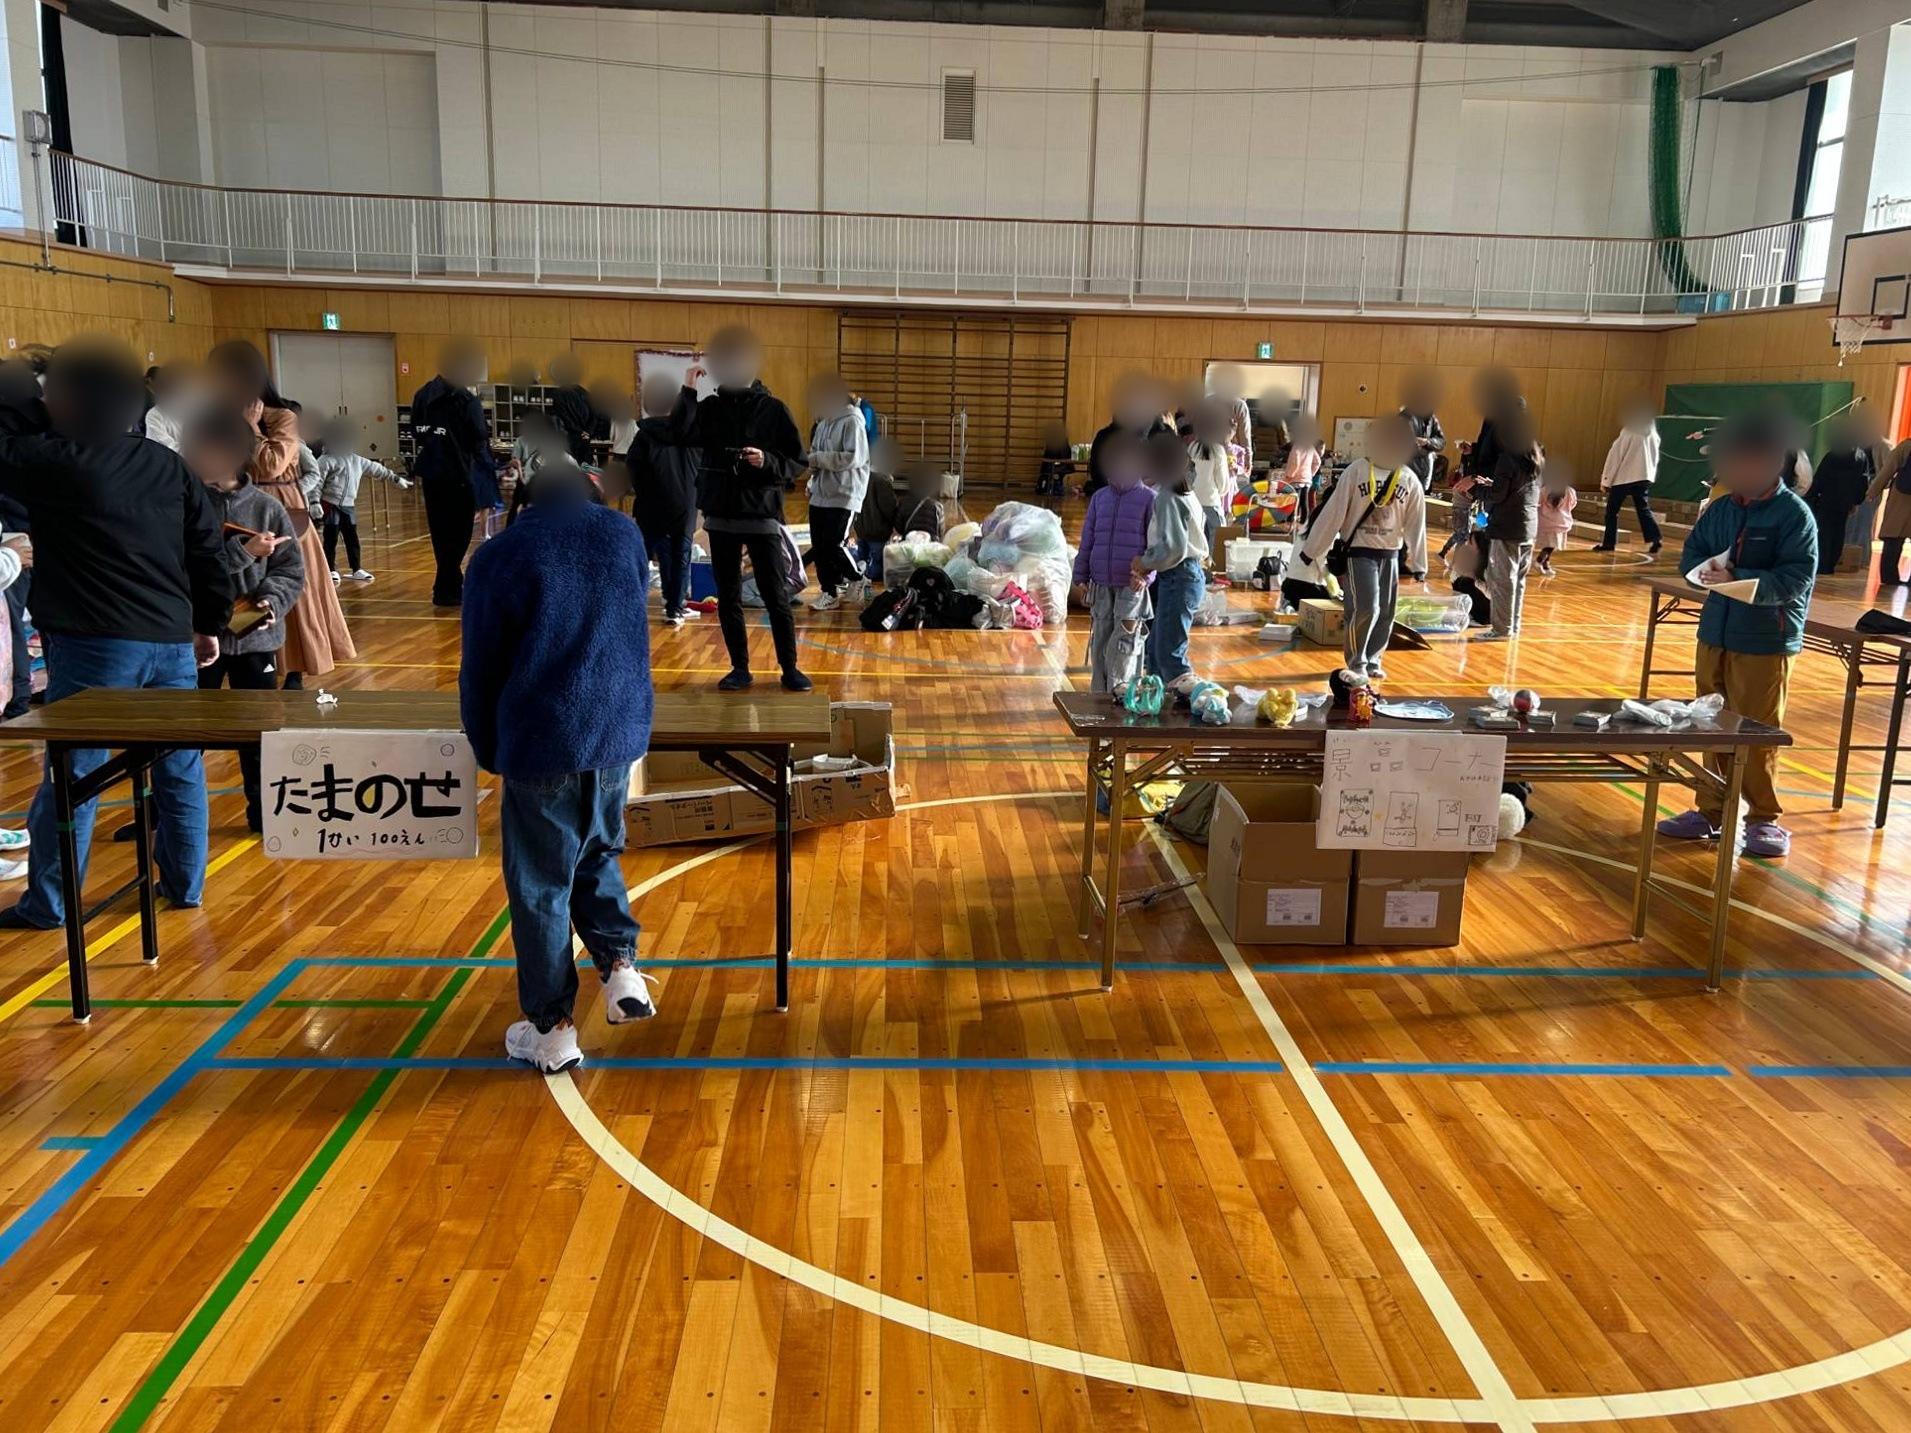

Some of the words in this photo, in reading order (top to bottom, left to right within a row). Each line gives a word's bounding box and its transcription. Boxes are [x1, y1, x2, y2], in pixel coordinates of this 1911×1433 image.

[270, 763, 462, 822] たまのせ
[371, 828, 425, 847] 100えん
